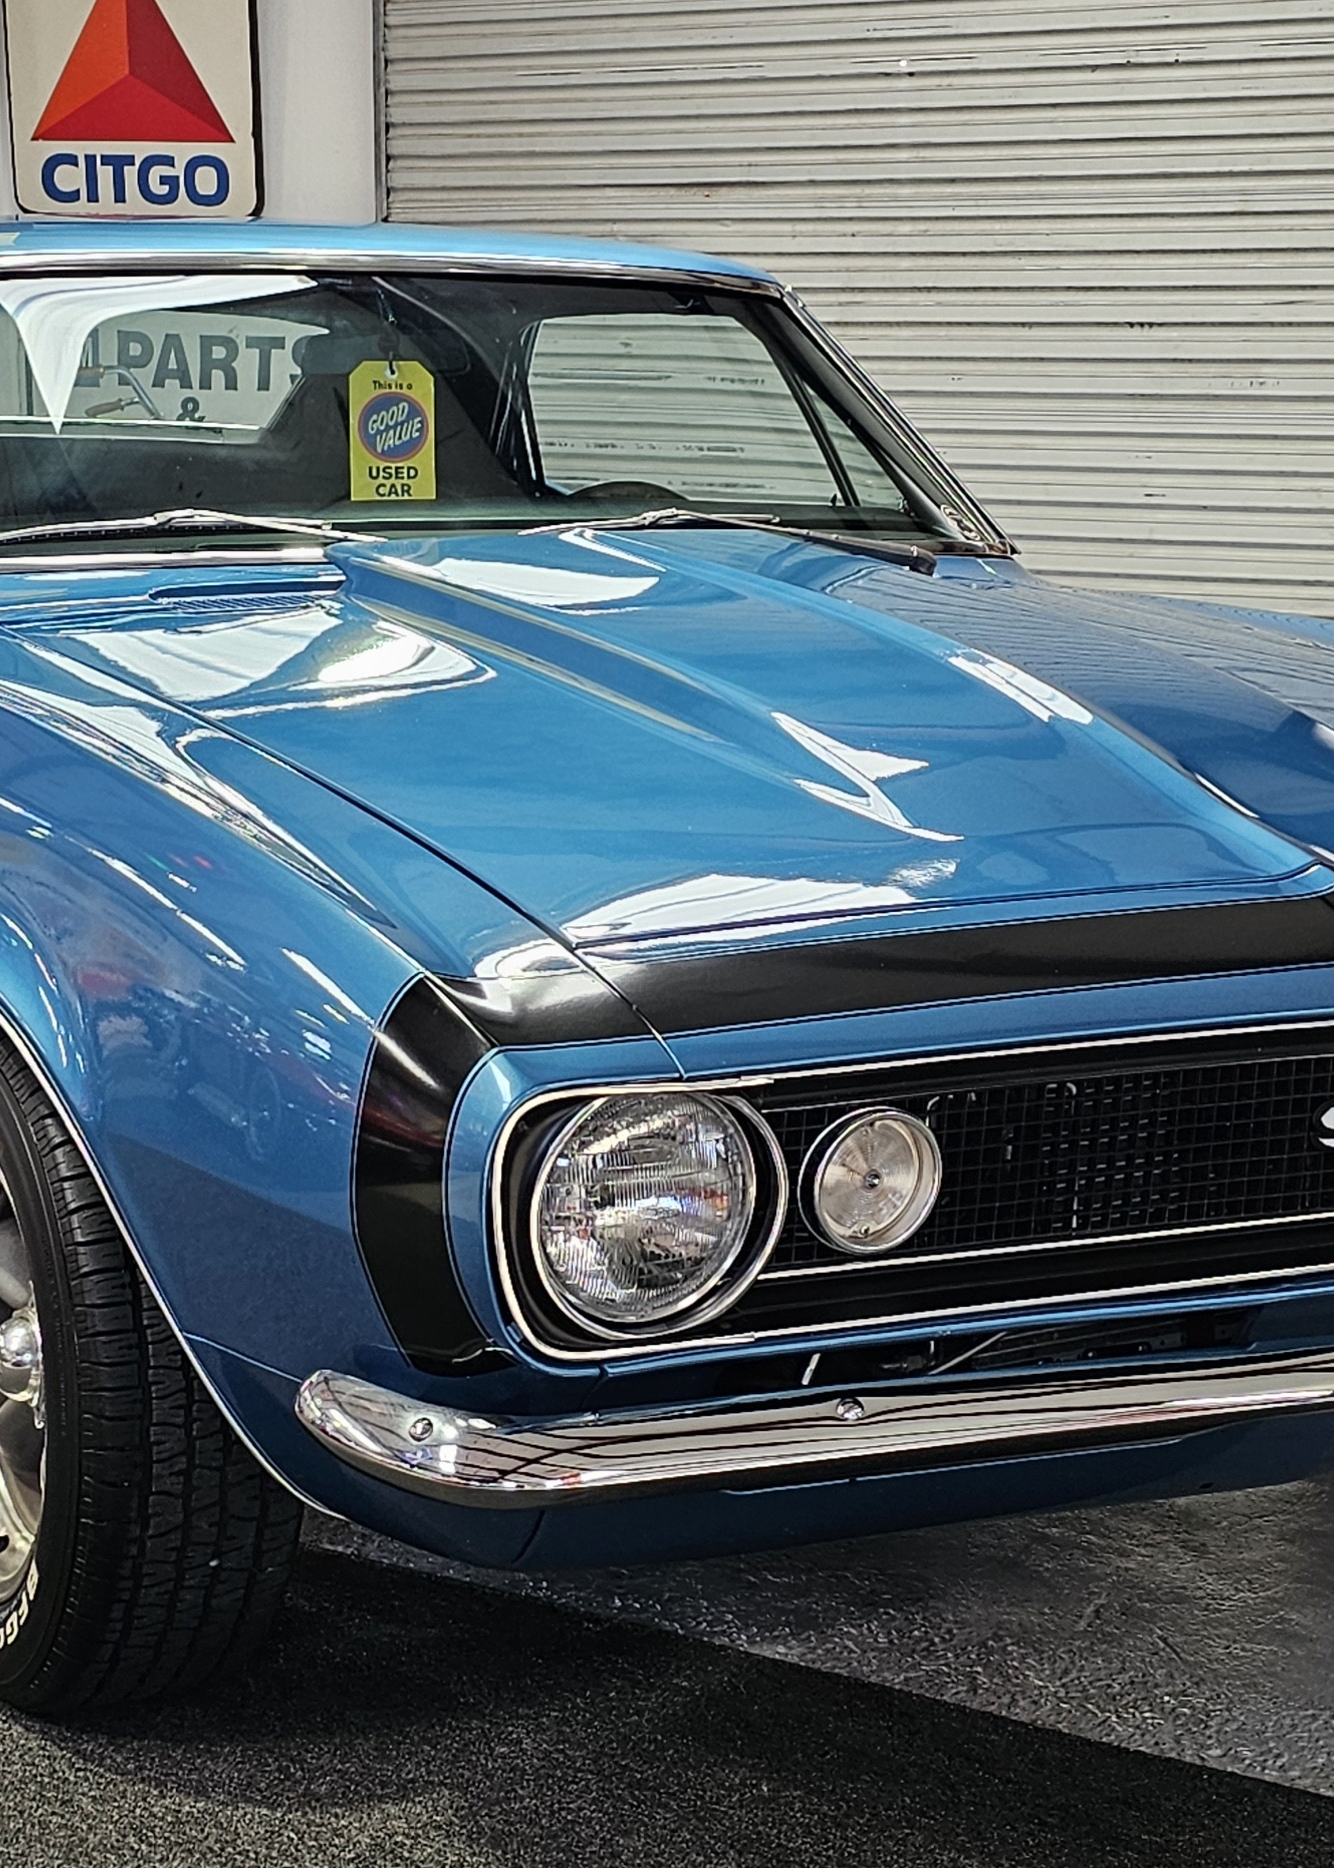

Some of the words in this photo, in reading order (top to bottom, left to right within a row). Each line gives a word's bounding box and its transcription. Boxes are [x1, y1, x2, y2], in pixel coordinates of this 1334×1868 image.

[41, 152, 230, 207] CITGO
[372, 380, 393, 391] This
[395, 381, 404, 391] is
[368, 401, 409, 434] GOOD
[376, 416, 422, 453] VALUE
[368, 466, 419, 480] USED
[375, 483, 413, 497] CAR
